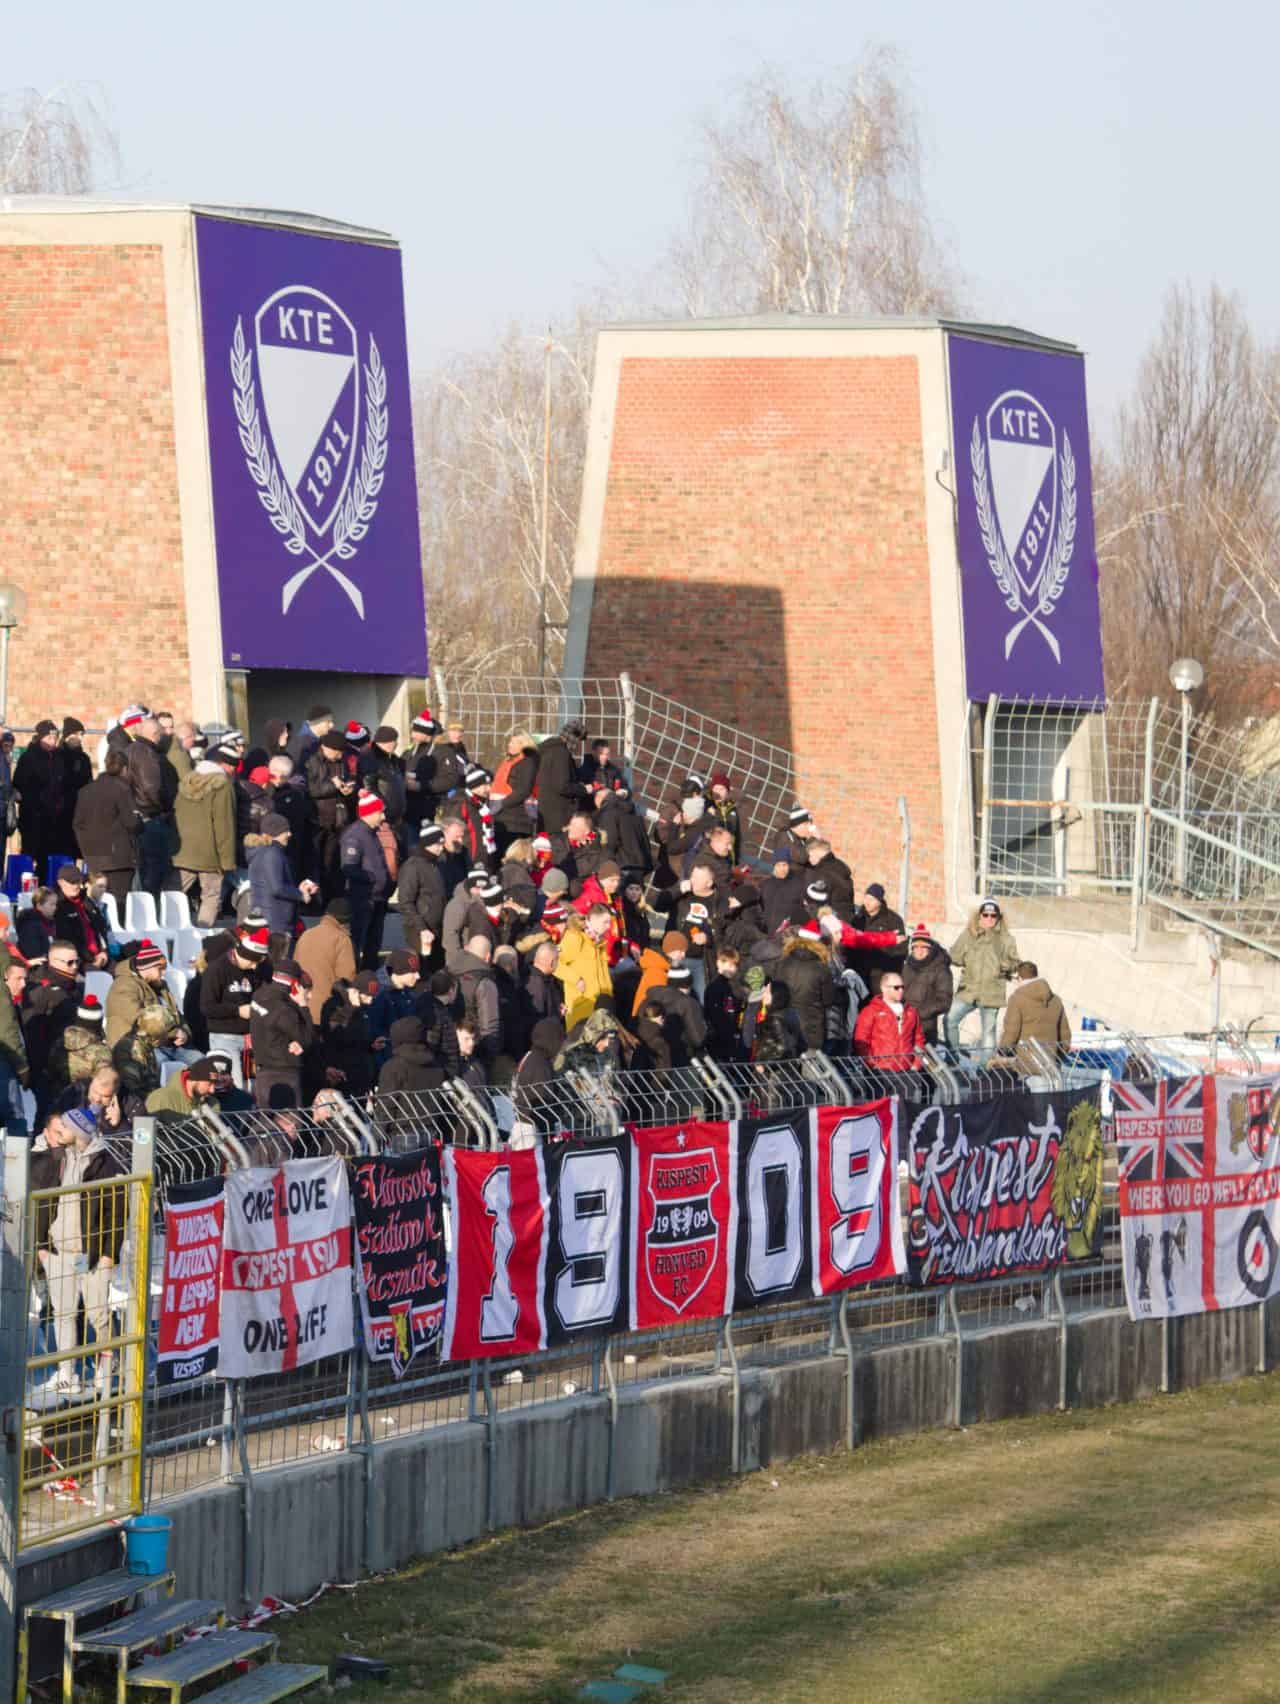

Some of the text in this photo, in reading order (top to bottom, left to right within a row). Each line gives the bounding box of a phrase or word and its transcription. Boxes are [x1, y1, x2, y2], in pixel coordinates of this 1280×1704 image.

[278, 306, 335, 346] KTE
[1002, 407, 1040, 440] KTE
[306, 419, 351, 507] 1911
[1019, 500, 1051, 572] 1911
[656, 1164, 709, 1190] KISPEST
[1166, 1184, 1191, 1208] YOU
[1194, 1182, 1210, 1205] GO
[243, 1177, 328, 1224] ONE LOVE
[479, 1112, 886, 1343] 1 9 0 9
[655, 1210, 709, 1233] 19 09
[673, 1276, 689, 1297] FC
[243, 1303, 328, 1354] ONE LIFE
